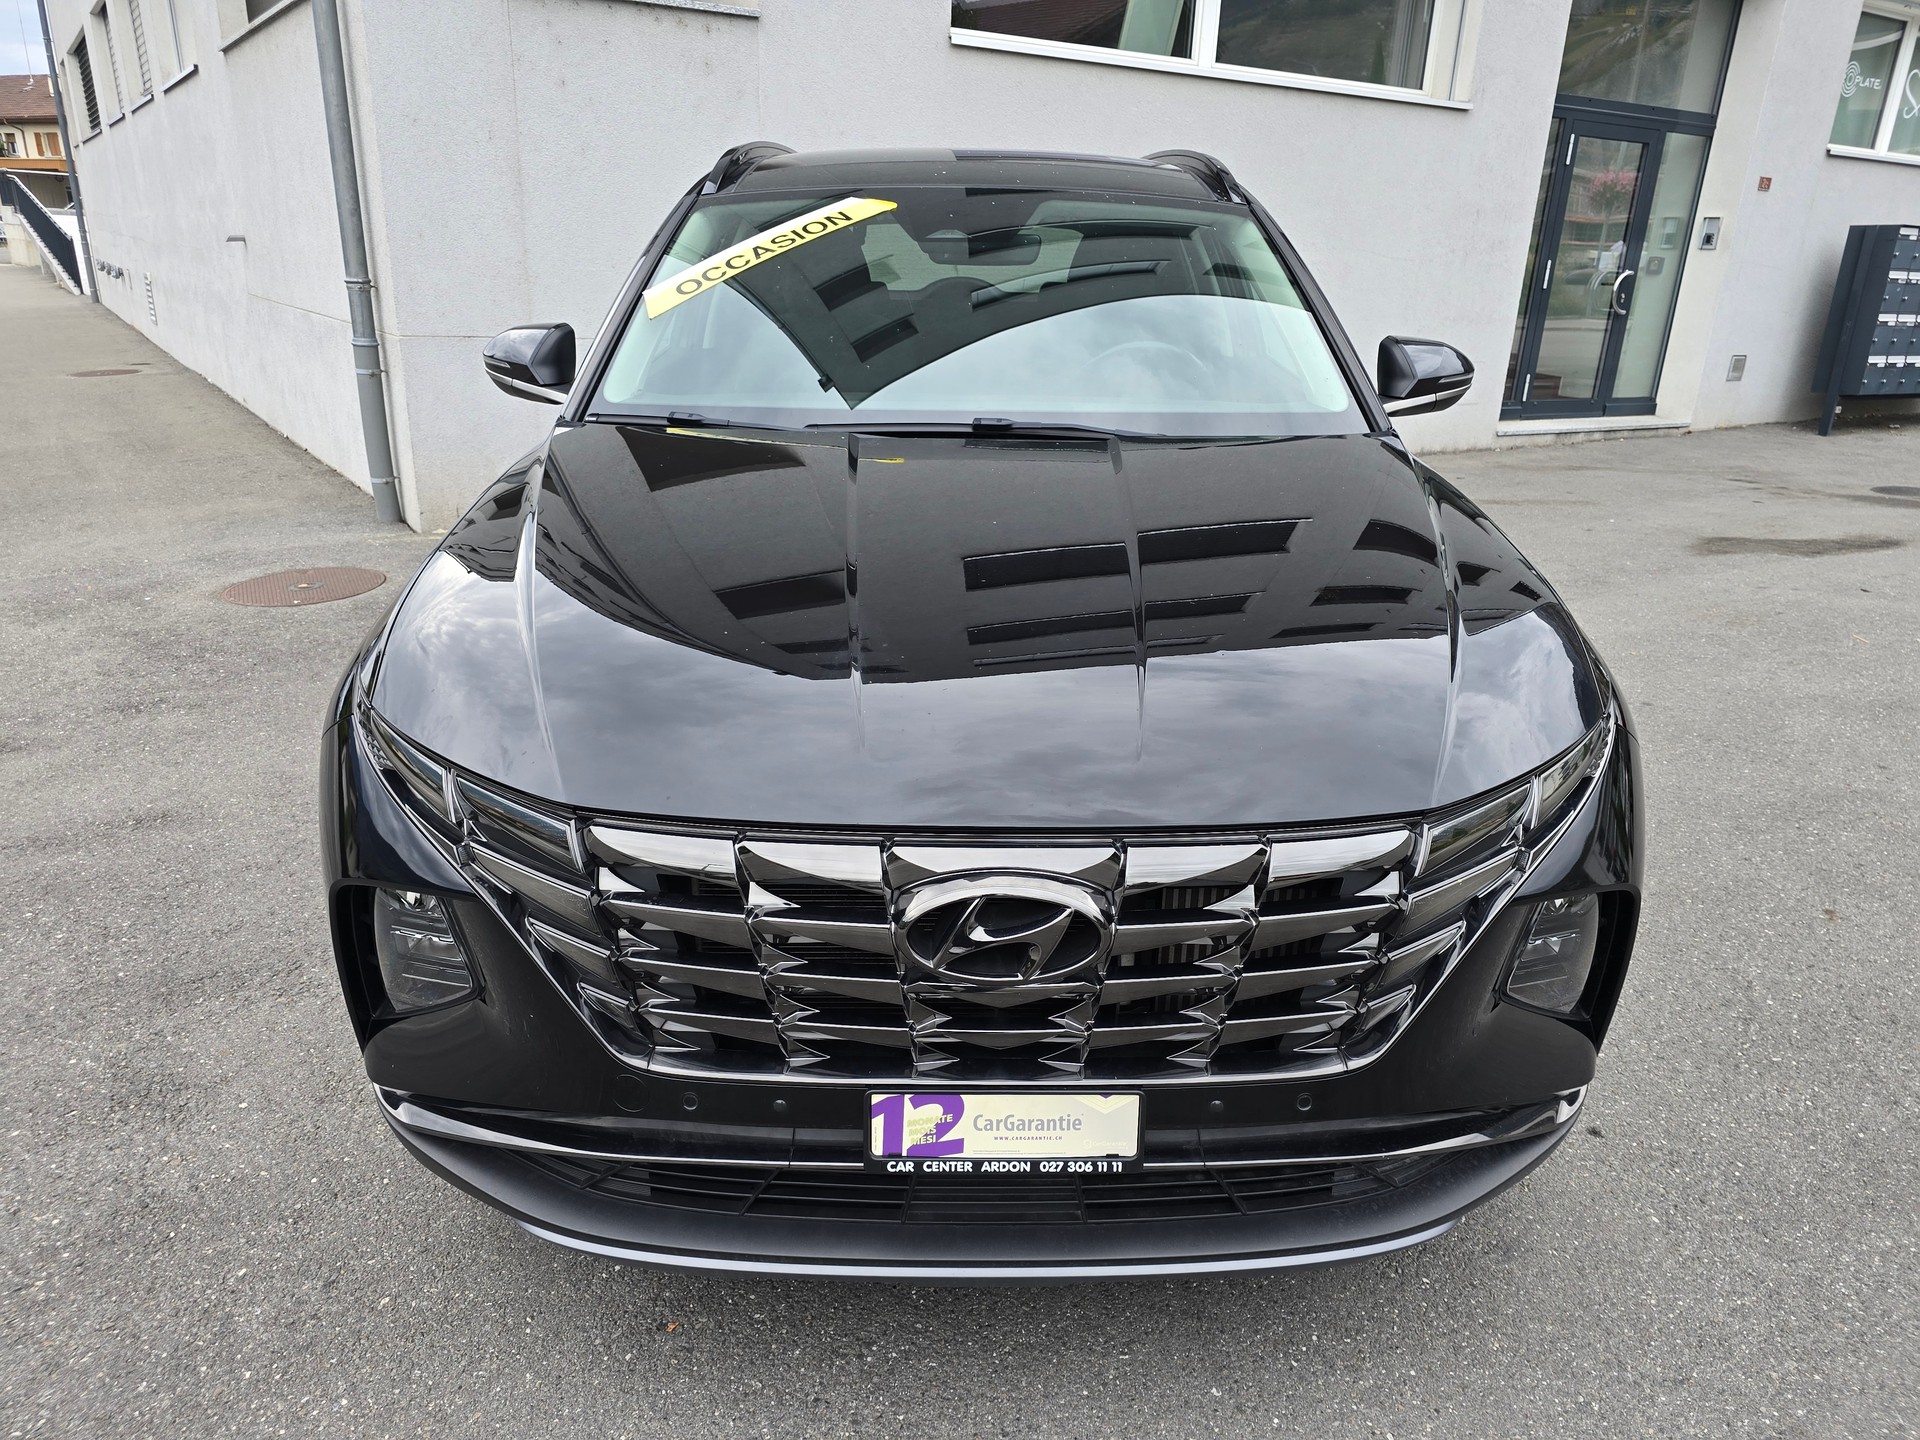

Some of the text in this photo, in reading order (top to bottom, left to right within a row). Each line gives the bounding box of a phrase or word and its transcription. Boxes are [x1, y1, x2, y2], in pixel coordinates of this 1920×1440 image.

[676, 211, 854, 295] OCCASION
[872, 1094, 965, 1157] 12
[907, 1114, 953, 1127] MONATE
[973, 1114, 1082, 1131] CarGarantie
[911, 1135, 937, 1145] MESI
[887, 1161, 1122, 1172] CAR CENTER ARDON 027 306 11 11
